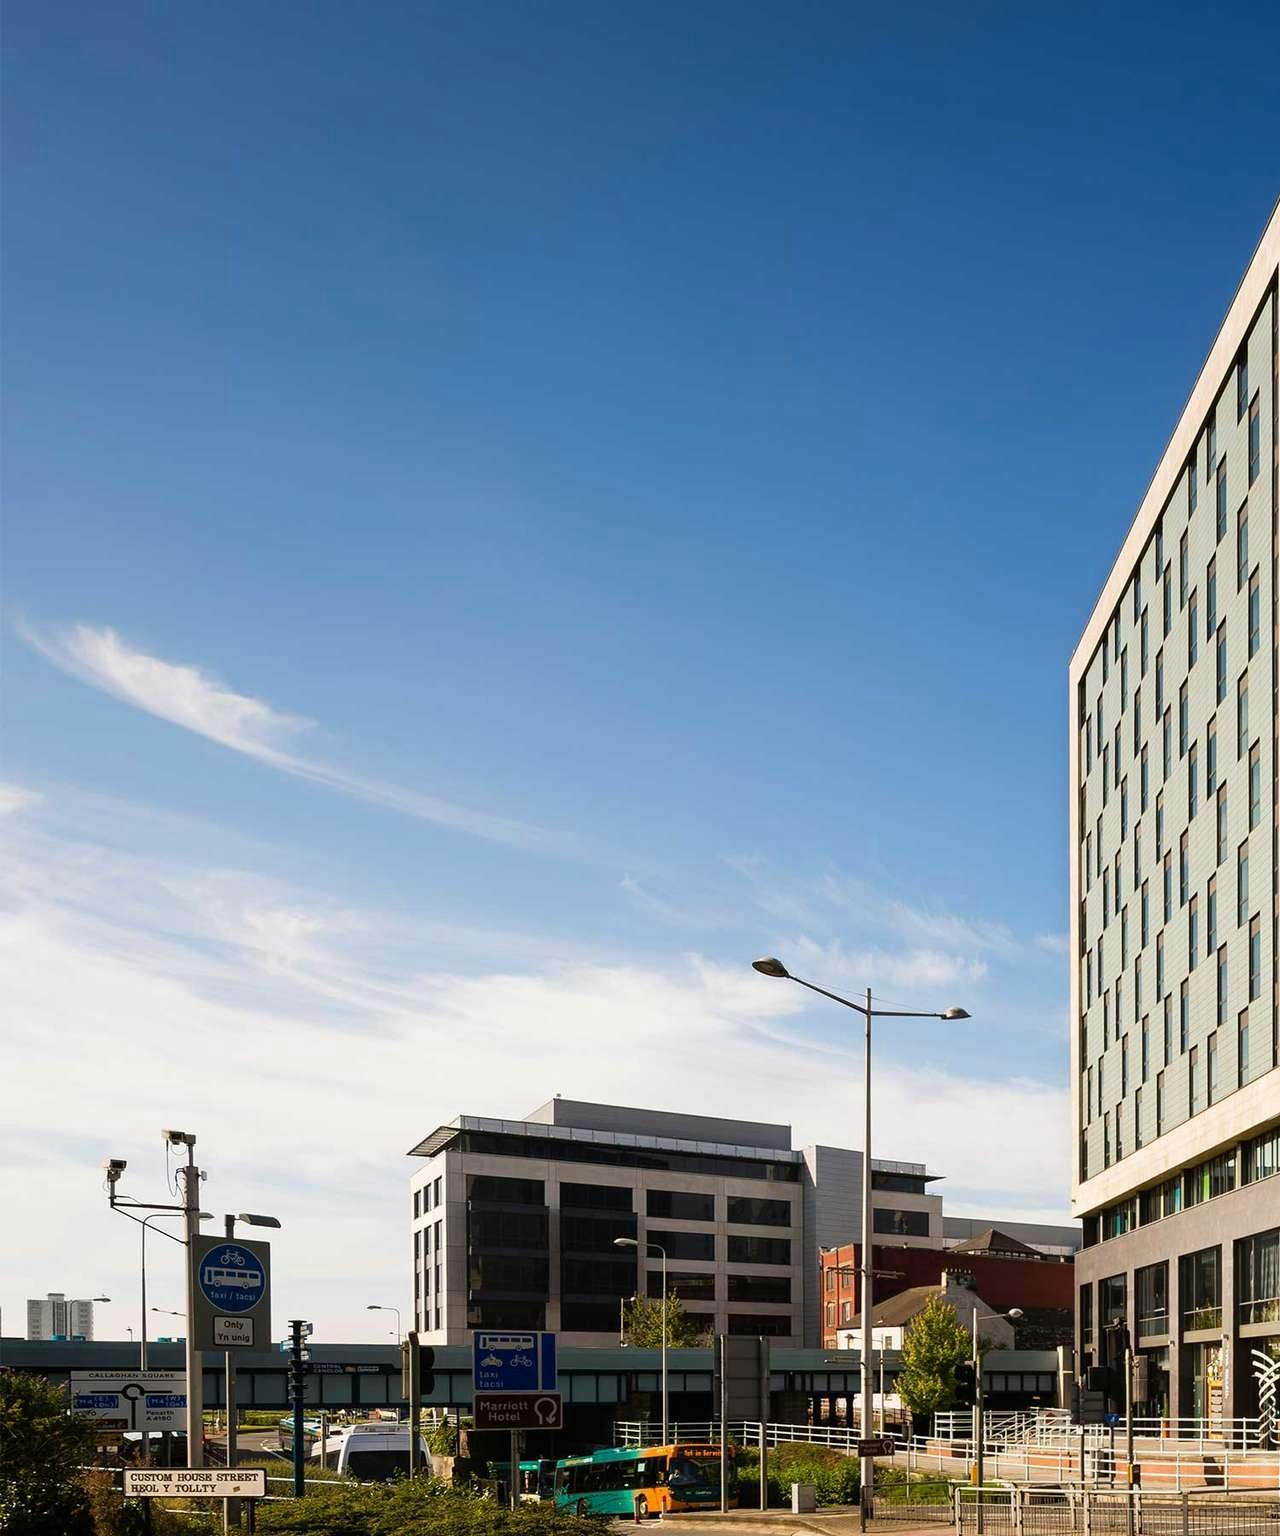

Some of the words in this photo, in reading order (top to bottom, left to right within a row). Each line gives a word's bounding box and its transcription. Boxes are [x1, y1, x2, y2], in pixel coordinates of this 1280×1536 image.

[210, 1291, 227, 1300] taxi
[223, 1320, 244, 1330] Only
[217, 1333, 229, 1341] Yn
[231, 1333, 250, 1343] unig
[479, 1380, 504, 1388] tacsi
[479, 1401, 529, 1411] Marriott
[488, 1411, 521, 1421] Hotel
[130, 1473, 173, 1482] CUSTOM
[177, 1473, 212, 1482] HOUSE
[216, 1473, 259, 1482] STREET
[131, 1484, 159, 1493] HEOL
[163, 1484, 170, 1493] Y
[174, 1484, 217, 1493] TOLLTY
